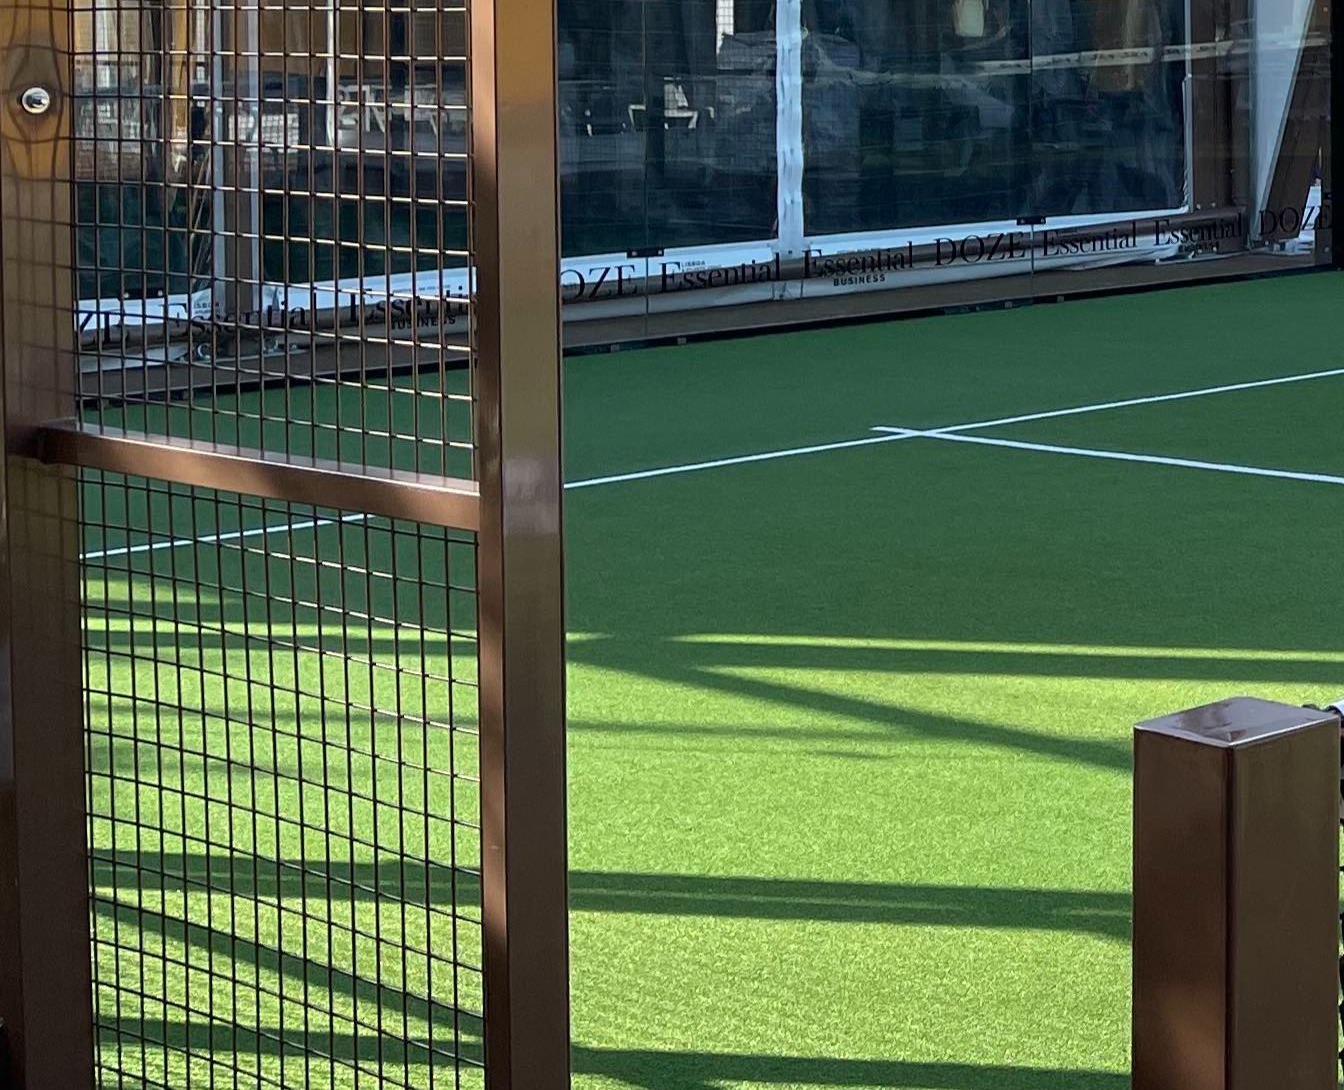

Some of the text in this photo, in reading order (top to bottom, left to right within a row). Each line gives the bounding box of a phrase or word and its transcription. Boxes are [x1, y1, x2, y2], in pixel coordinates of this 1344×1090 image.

[560, 264, 638, 300] OZE
[658, 252, 782, 294] Essential
[802, 240, 914, 279] Essential
[933, 231, 1026, 266] DOZE
[1042, 221, 1137, 257] Essential
[1153, 213, 1242, 247] Essential
[1258, 205, 1332, 237] DOZE
[833, 273, 886, 287] BUSINESS
